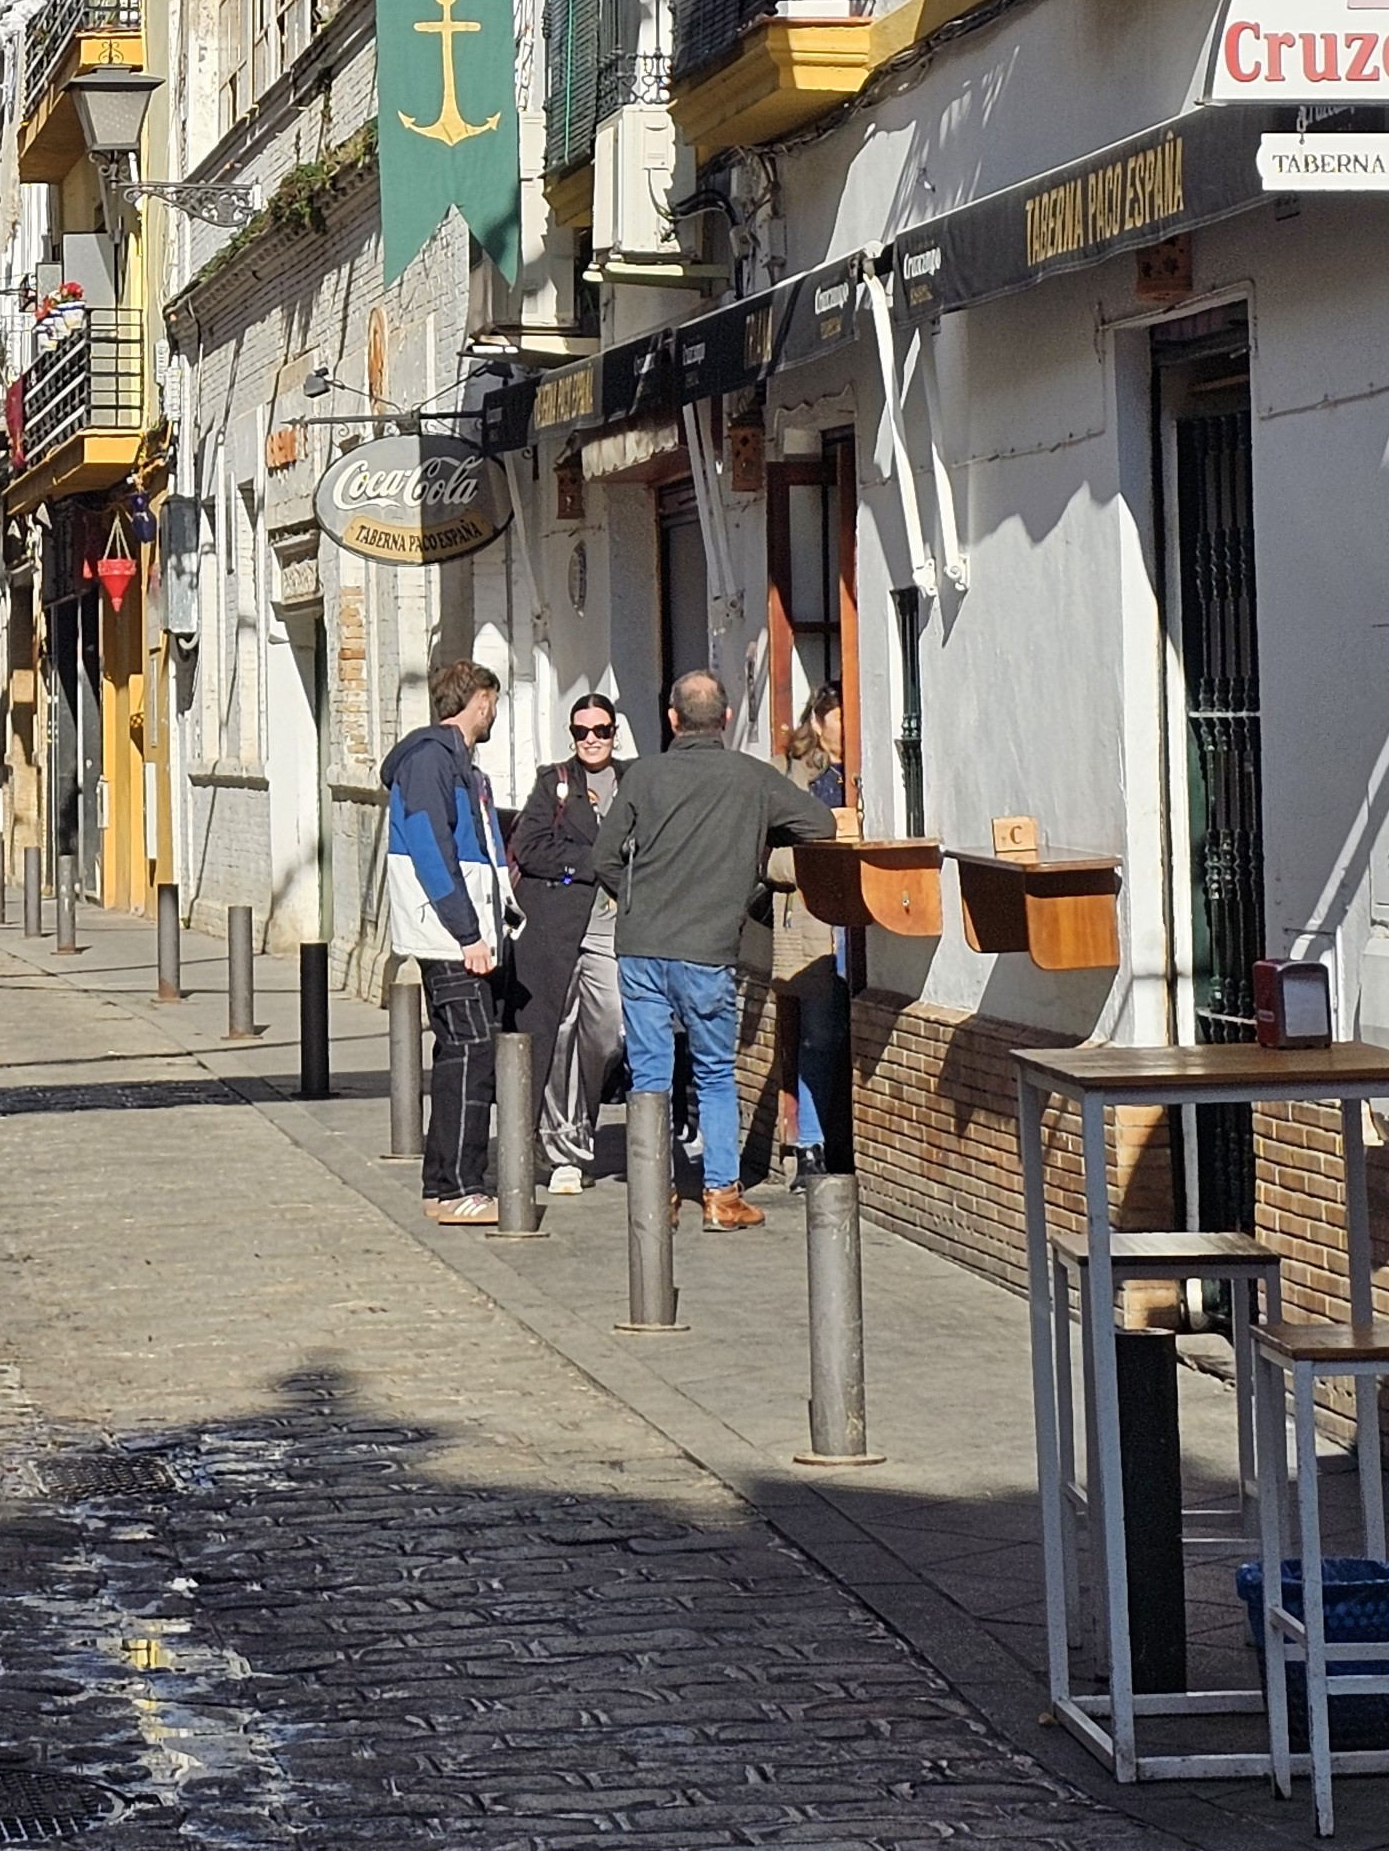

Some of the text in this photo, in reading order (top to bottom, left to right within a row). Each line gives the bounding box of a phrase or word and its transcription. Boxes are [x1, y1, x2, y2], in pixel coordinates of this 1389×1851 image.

[1224, 20, 1389, 83] Cruz
[1271, 153, 1387, 175] TABERNA
[1024, 129, 1185, 268] TABERNA PACO ESPAÑA
[332, 454, 485, 512] Coca-Cola
[354, 519, 483, 553] TABERNA PACO ESPAÑA
[1009, 824, 1023, 845] C
